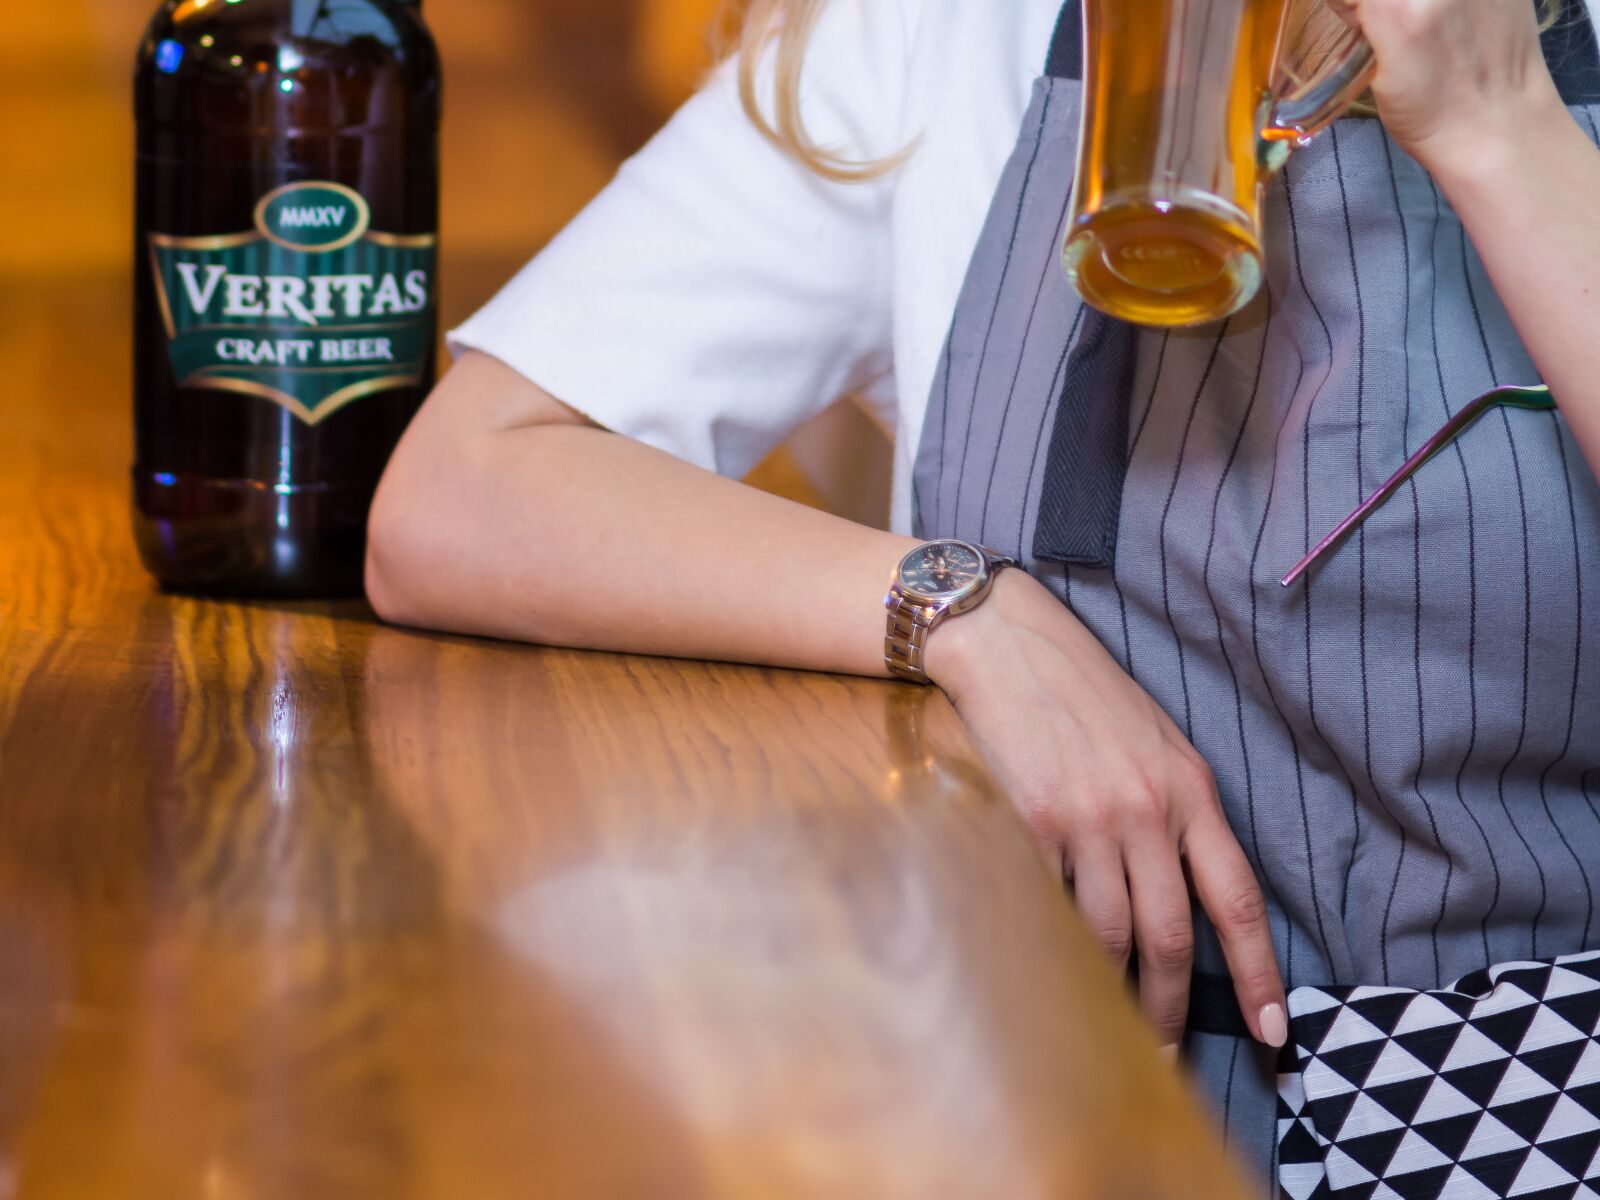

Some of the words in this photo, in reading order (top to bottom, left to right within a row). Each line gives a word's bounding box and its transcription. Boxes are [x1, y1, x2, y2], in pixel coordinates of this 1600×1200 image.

[279, 205, 346, 228] MMXV
[176, 262, 428, 326] VERITAS
[215, 337, 314, 364] CRAFT
[319, 337, 394, 361] BEER
